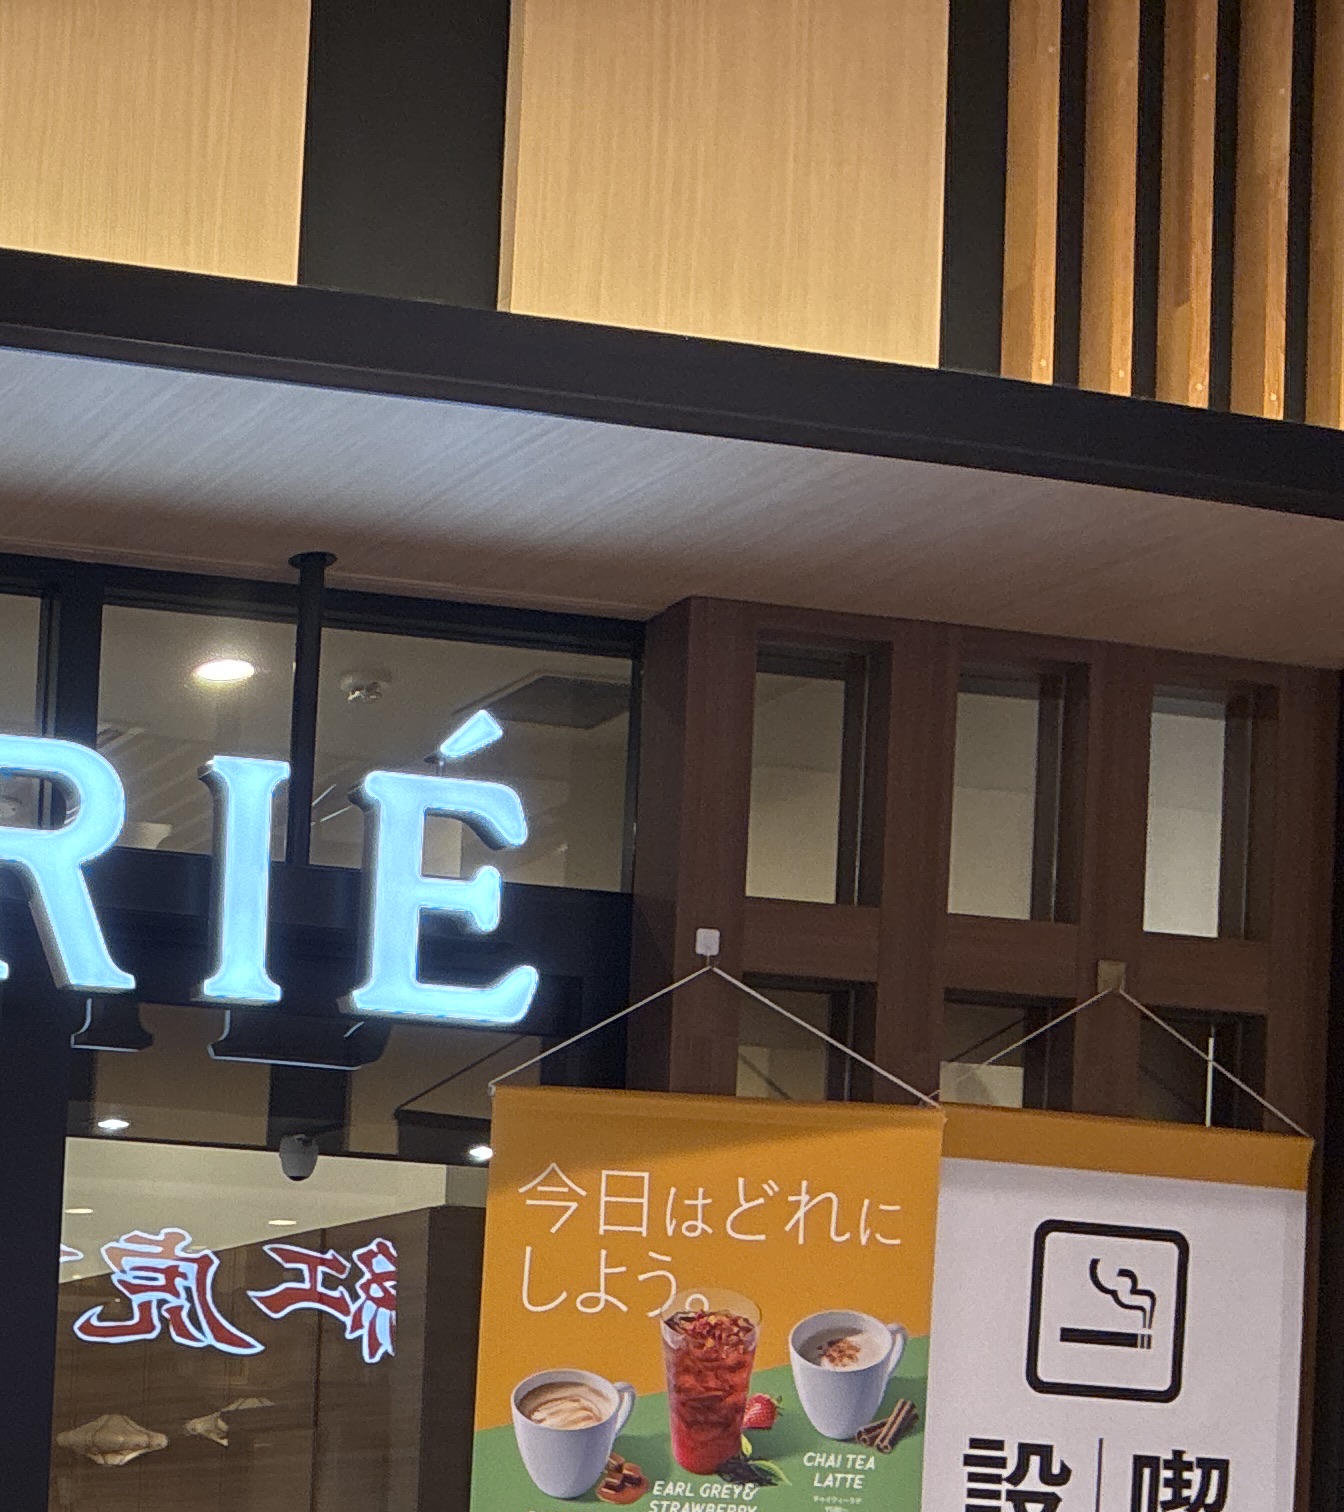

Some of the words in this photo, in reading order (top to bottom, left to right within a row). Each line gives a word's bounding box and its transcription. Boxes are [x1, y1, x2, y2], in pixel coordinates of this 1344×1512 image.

[518, 1162, 902, 1247] 今日はどれに
[522, 1245, 709, 1319] しよう。
[803, 1451, 842, 1469] CHAI
[846, 1454, 876, 1471] TEA
[652, 1480, 695, 1497] EARL
[813, 1473, 865, 1490] LATTE
